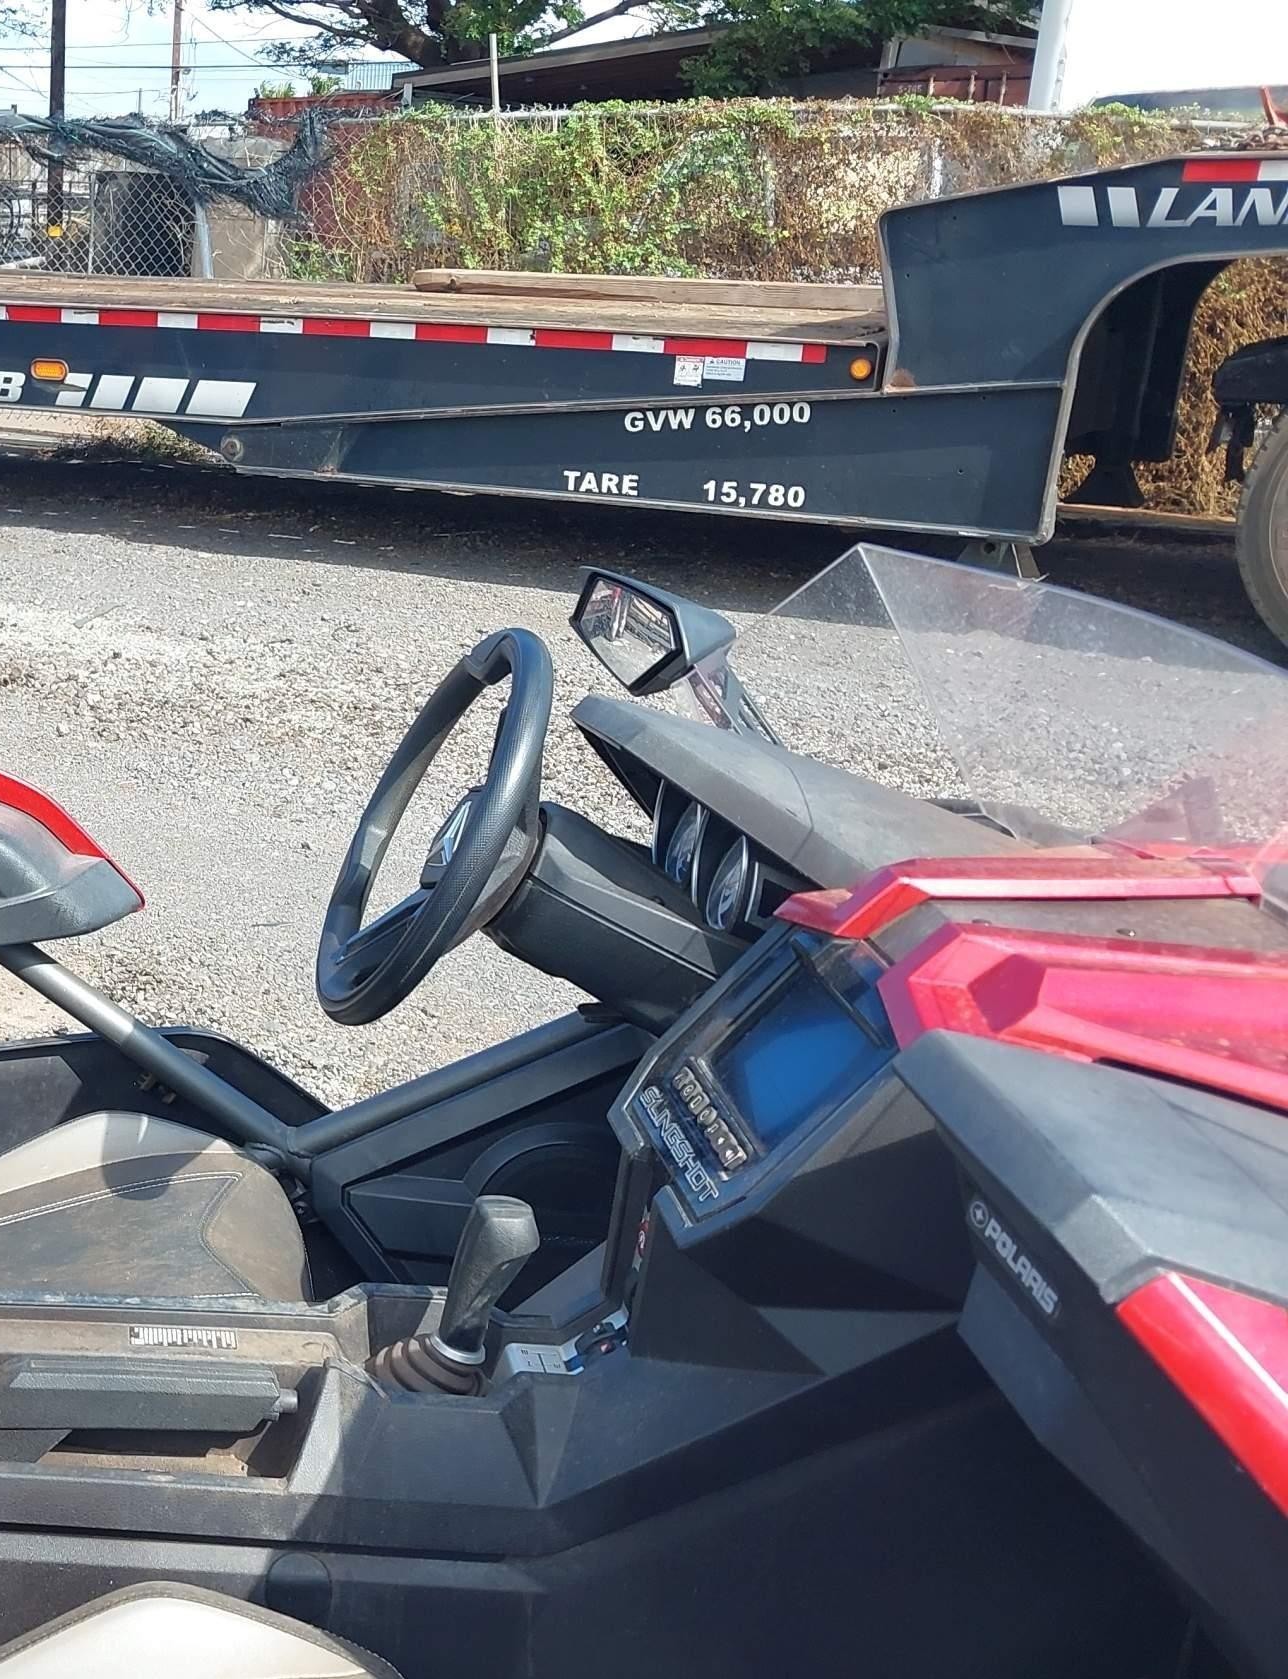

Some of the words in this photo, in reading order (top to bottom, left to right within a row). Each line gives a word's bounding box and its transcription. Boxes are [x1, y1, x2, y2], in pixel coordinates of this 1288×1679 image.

[1145, 187, 1288, 228] LAN
[624, 408, 696, 433] GVW
[705, 402, 811, 433] 66,000
[563, 470, 639, 496] TARE
[703, 480, 806, 508] 15,780
[640, 1086, 719, 1202] SLINGSHOT
[984, 1217, 1059, 1314] POLARIS
